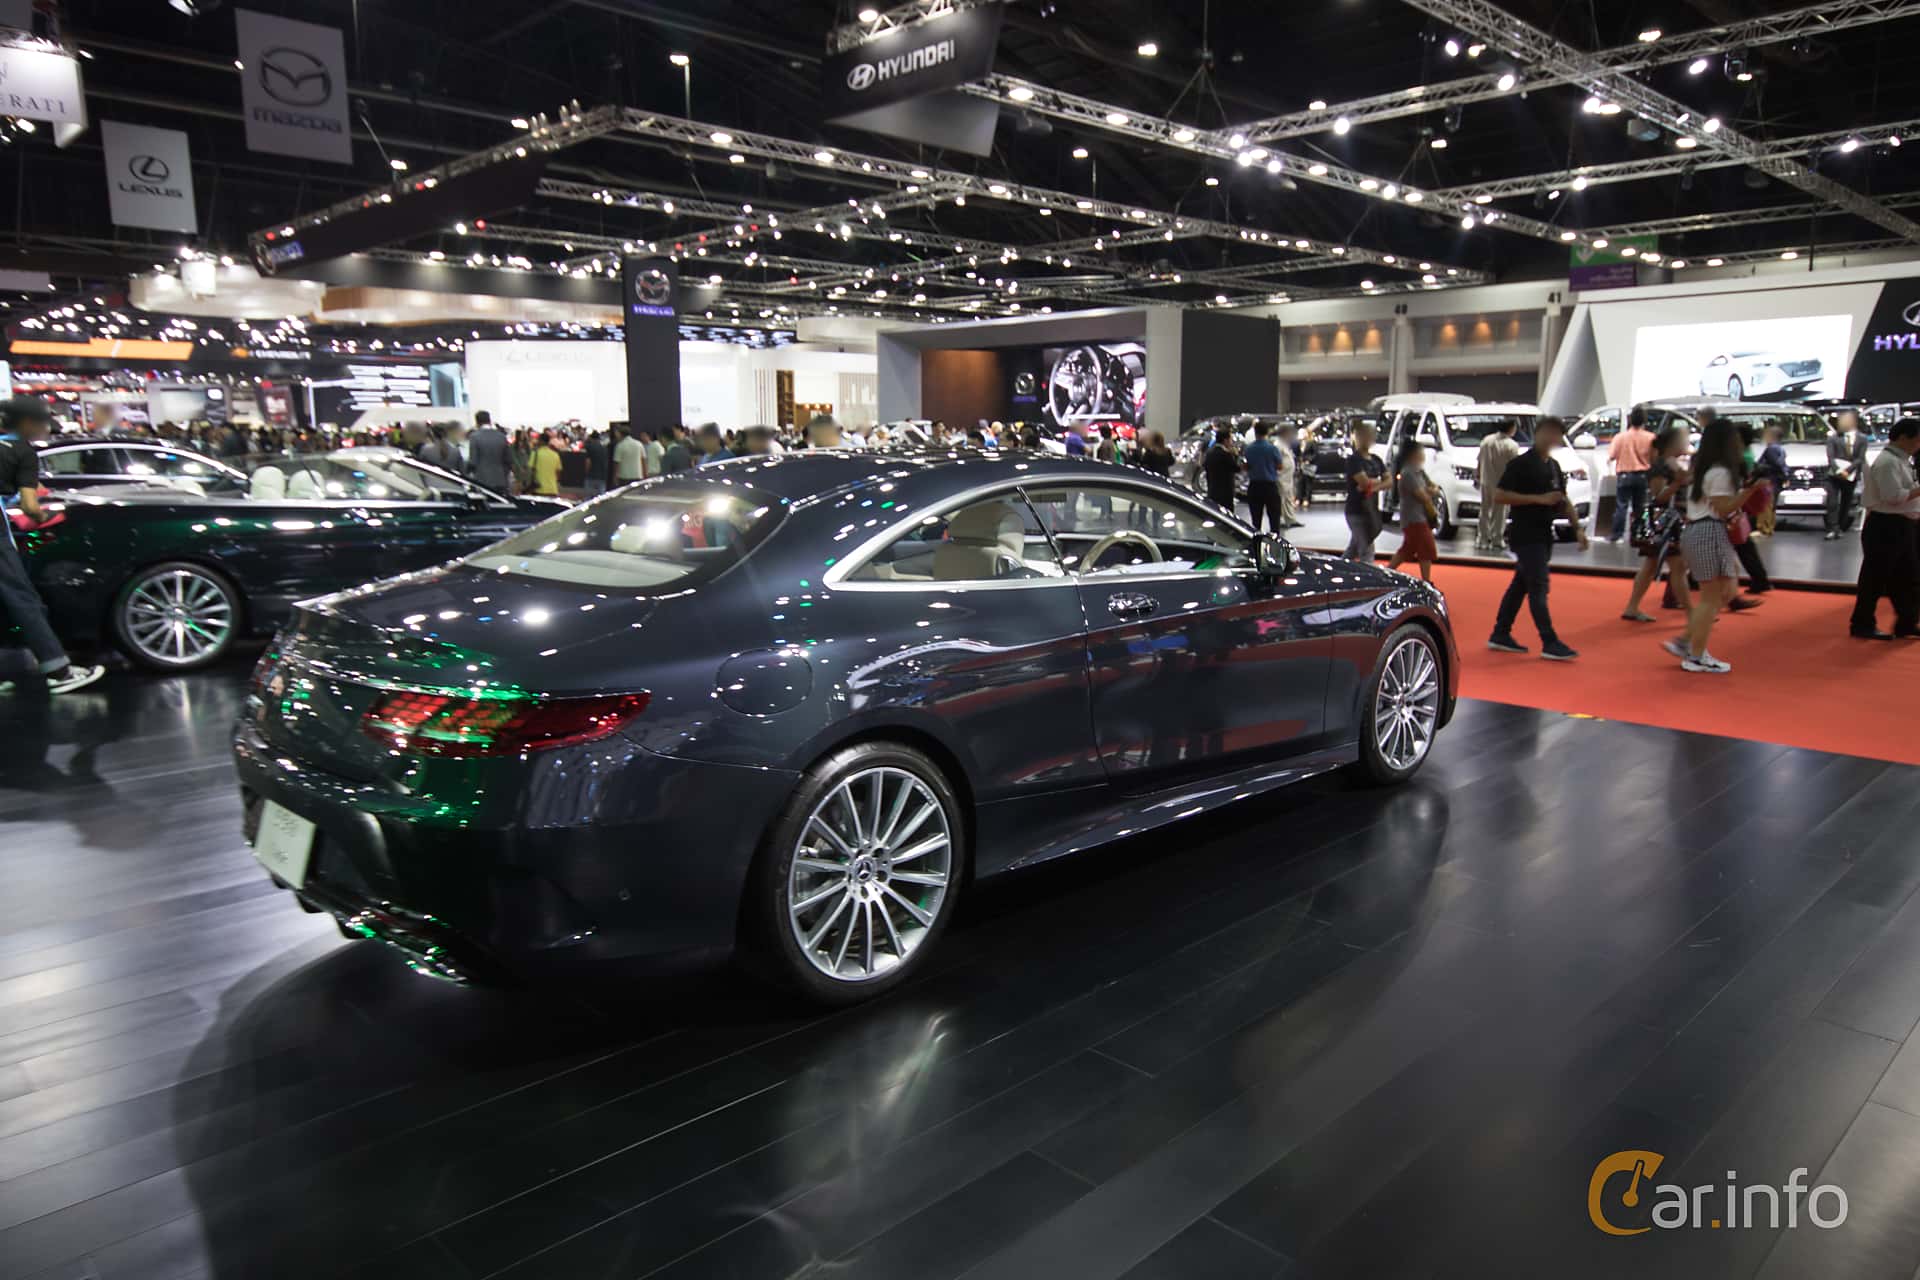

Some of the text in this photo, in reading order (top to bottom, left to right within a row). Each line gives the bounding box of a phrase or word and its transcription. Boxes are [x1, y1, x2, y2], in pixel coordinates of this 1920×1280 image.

[878, 39, 955, 80] HYUNDAI
[253, 107, 343, 134] mazda
[118, 182, 184, 199] LEXUS
[1547, 291, 1562, 303] 41
